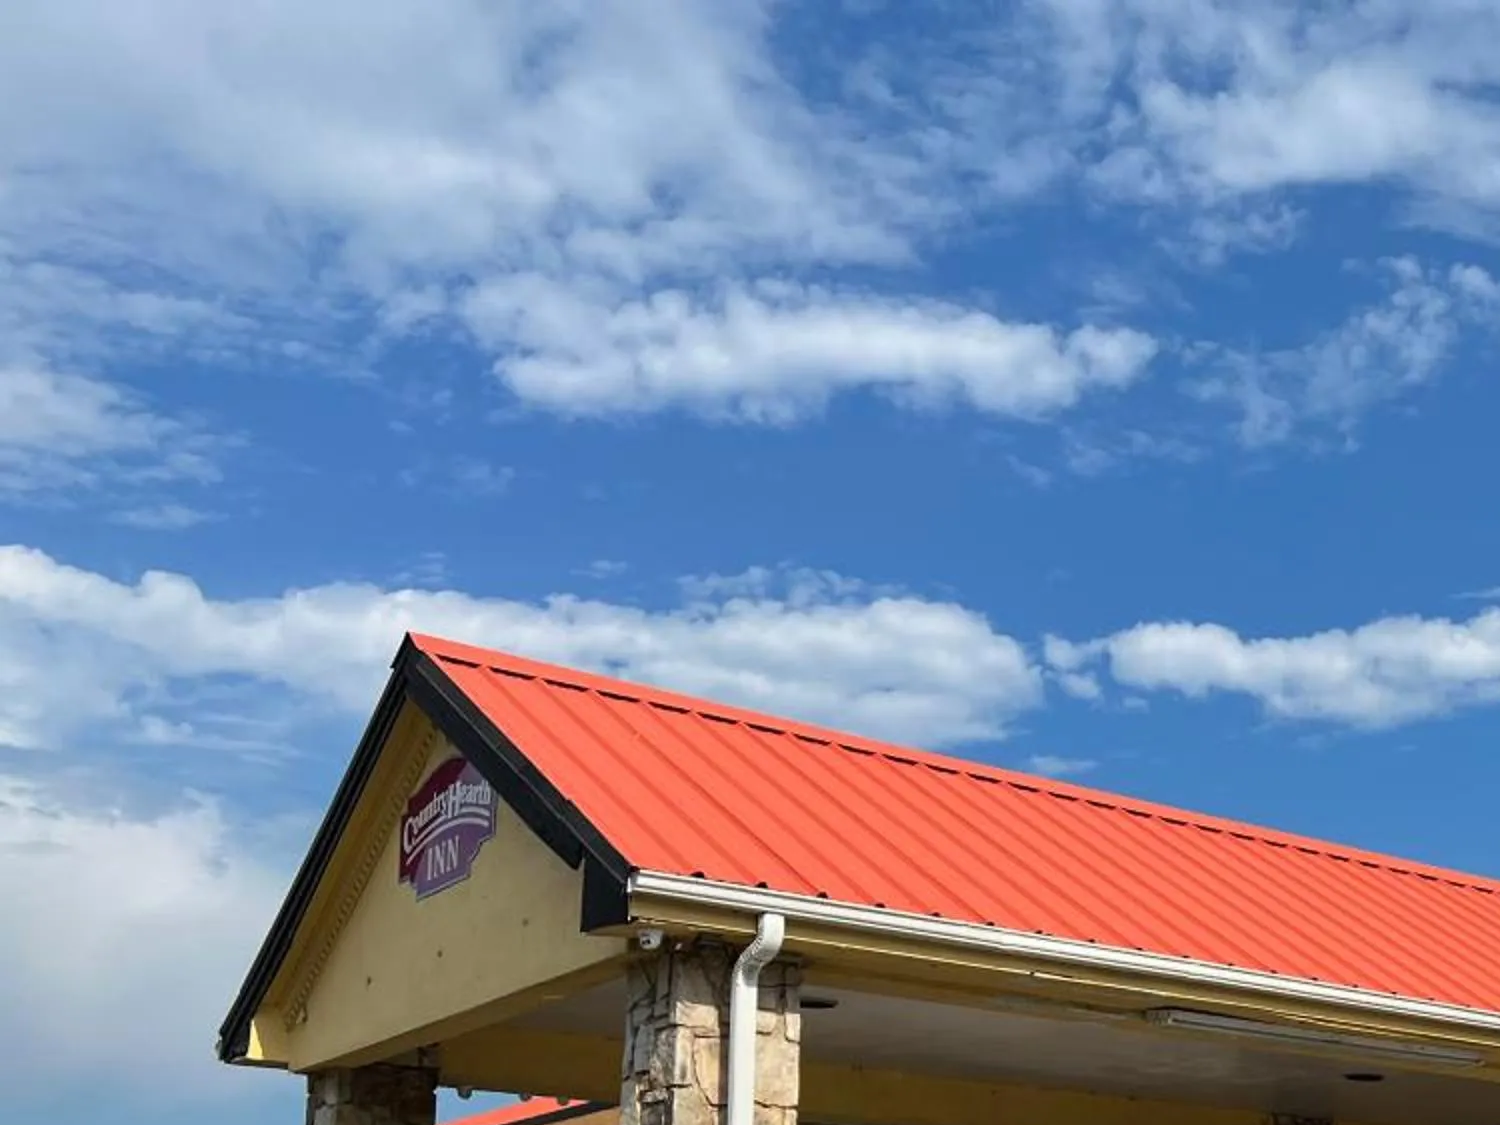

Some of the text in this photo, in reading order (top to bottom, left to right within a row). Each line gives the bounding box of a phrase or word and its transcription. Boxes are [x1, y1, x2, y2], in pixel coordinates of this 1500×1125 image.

[404, 779, 492, 854] Country Hearth
[427, 835, 460, 881] INN
